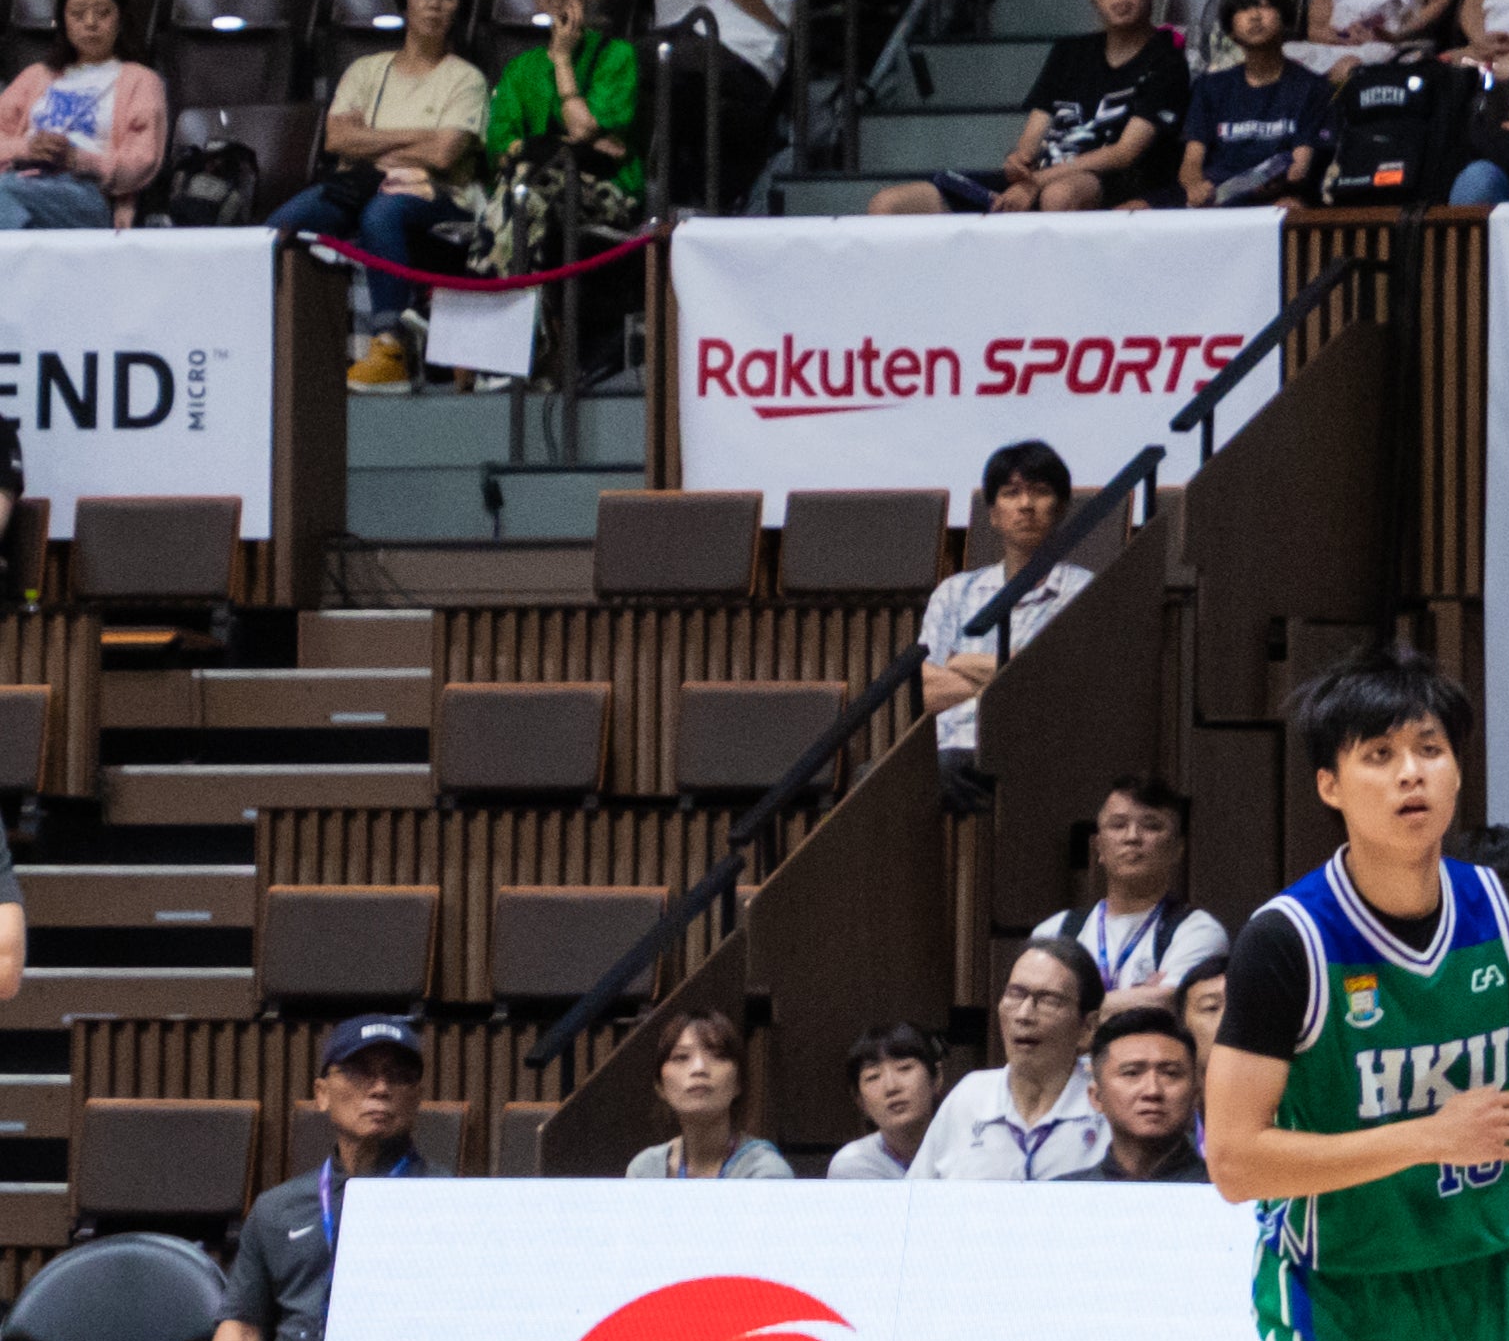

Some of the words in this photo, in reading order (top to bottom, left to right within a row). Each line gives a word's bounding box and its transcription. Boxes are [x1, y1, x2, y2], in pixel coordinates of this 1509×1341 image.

[187, 348, 207, 432] MICRO
[698, 334, 962, 397] Rakuten
[975, 334, 1245, 396] SPORTS
